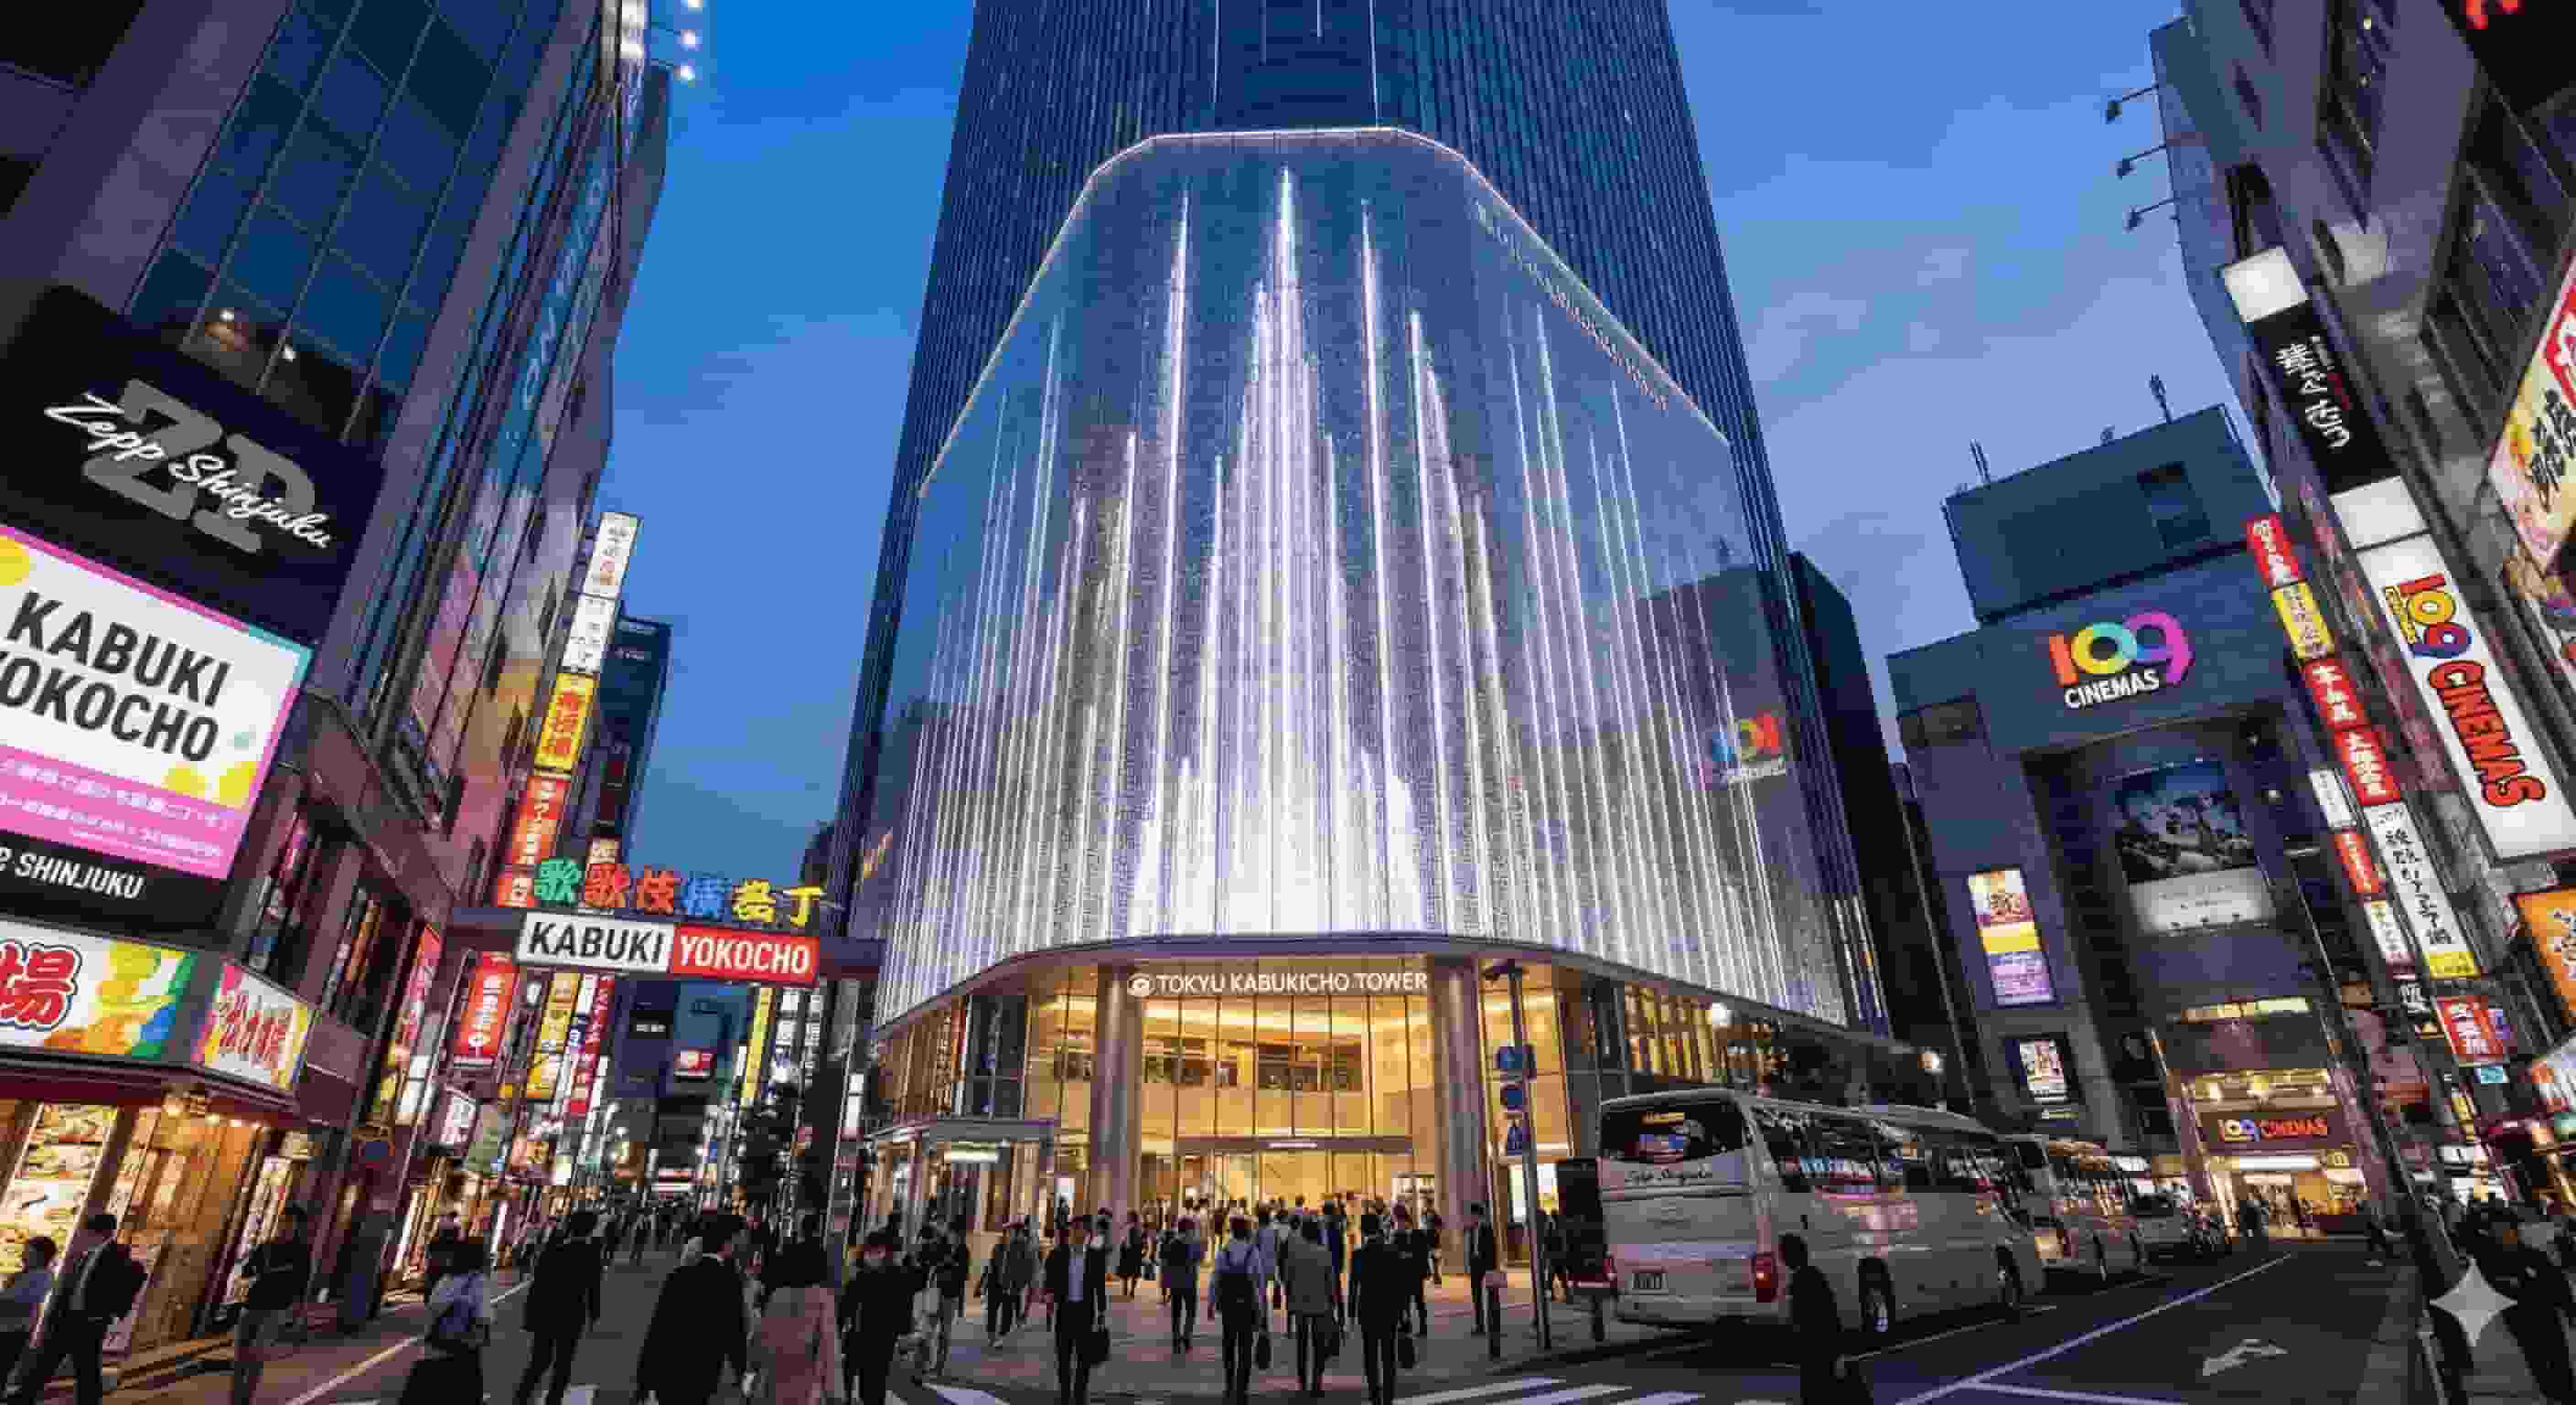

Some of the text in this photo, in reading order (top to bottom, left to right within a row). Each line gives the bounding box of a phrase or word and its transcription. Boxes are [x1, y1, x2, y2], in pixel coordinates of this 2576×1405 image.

[44, 391, 334, 549] Zepp Shinjuku
[6, 591, 230, 707] KABUKI
[2048, 611, 2194, 686] 109
[0, 650, 220, 761] OKOCHO
[2064, 669, 2160, 709] CINEMAS
[2399, 574, 2547, 807] 109 CINEMAS
[15, 852, 144, 899] SHINJUKU
[528, 920, 810, 975] KABUKI YOKOCHO
[1155, 971, 1429, 992] TOKYU KABUKICHO TOWER
